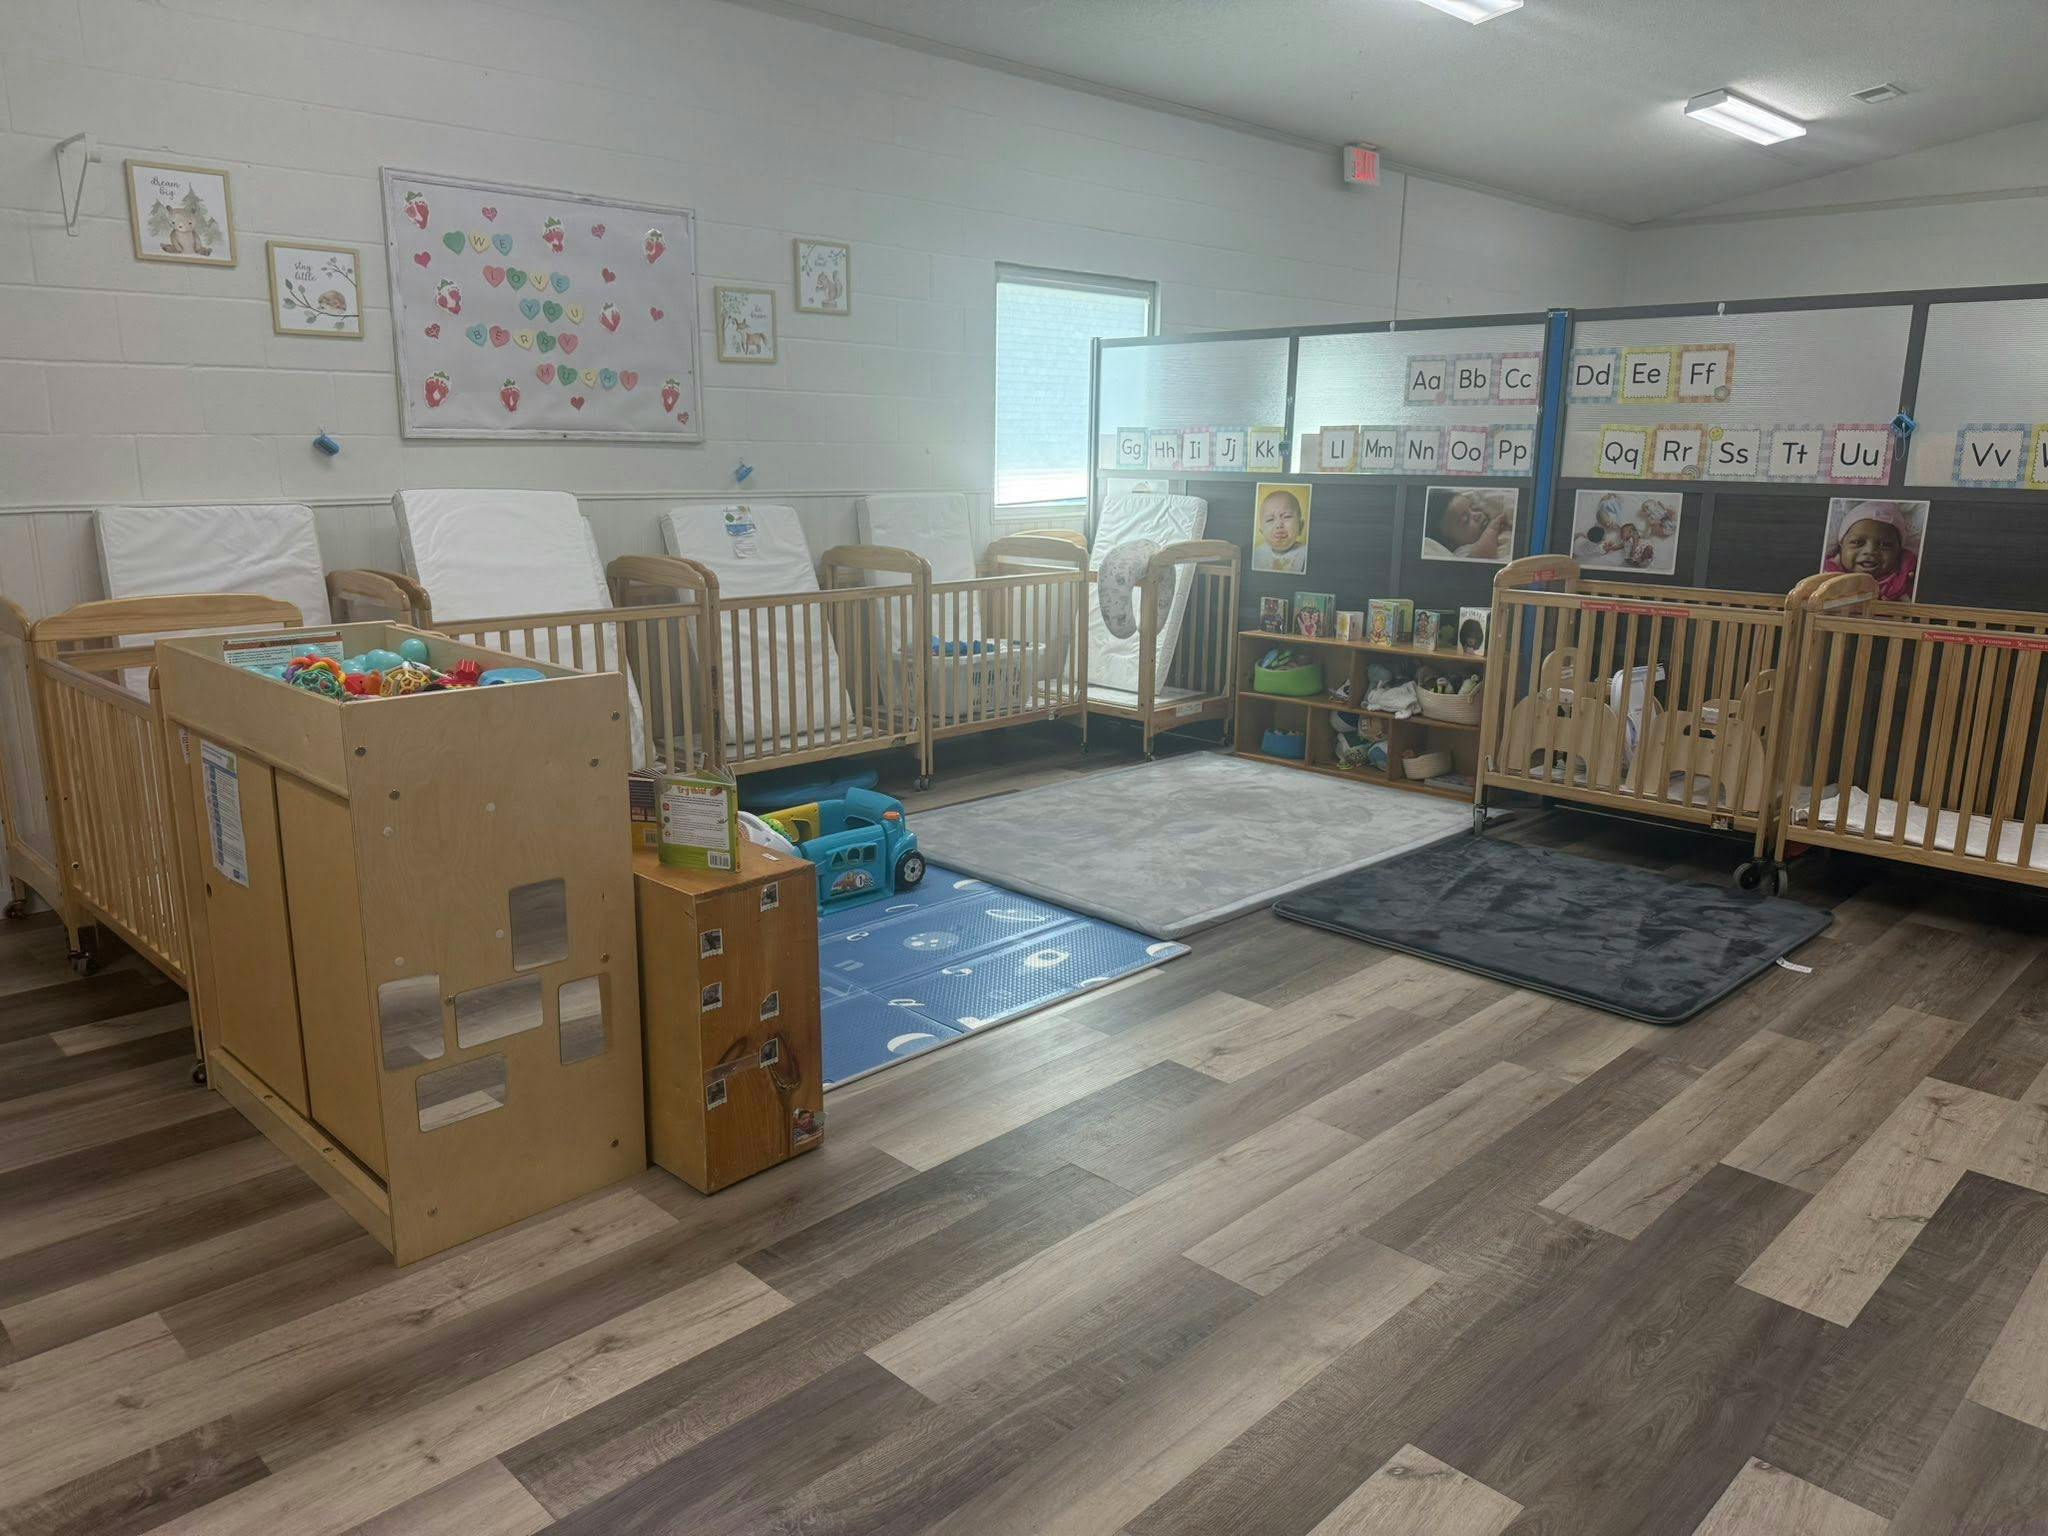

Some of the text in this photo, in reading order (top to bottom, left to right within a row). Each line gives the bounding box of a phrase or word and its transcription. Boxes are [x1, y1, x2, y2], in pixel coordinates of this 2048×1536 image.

[473, 236, 506, 249] WE
[491, 271, 563, 288] LOVE
[526, 304, 579, 319] YOU
[473, 328, 571, 347] BERRY
[1413, 368, 1532, 392] Aa Bb Cc
[1575, 361, 1718, 387] Dd Ee Ff
[1121, 438, 1276, 460] Gg Hh Ii Jj Kk
[1330, 439, 1528, 466] Ll Mm Nn Oo Pp
[1603, 440, 1880, 471] Qq Rr Ss Tt Uu
[1971, 442, 2012, 467] Vv
